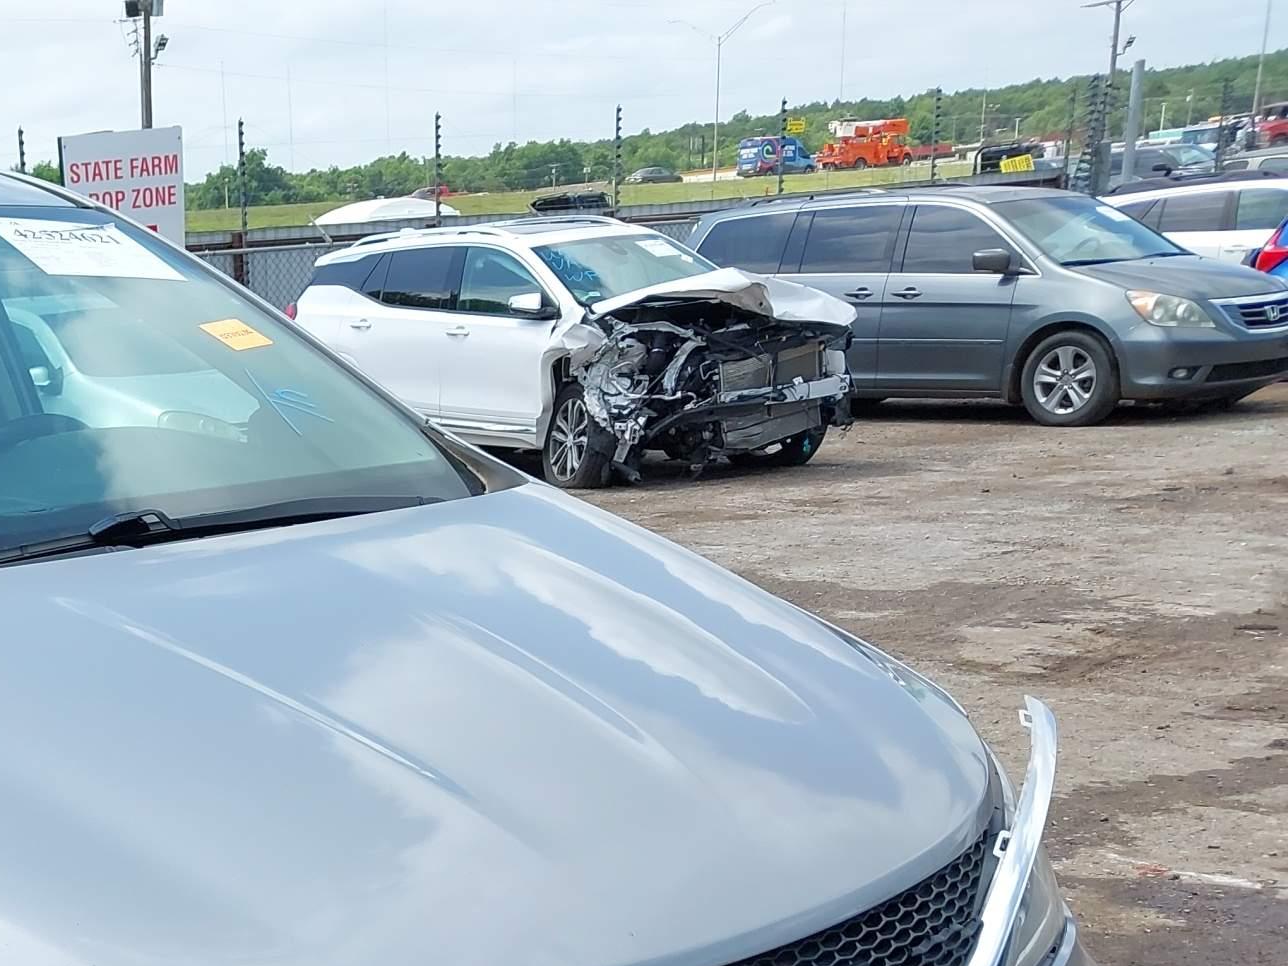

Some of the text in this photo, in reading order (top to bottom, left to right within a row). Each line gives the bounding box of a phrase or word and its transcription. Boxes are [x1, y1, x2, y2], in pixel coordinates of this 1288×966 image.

[69, 153, 179, 184] STATE FARM
[88, 185, 177, 211] OP ZONE
